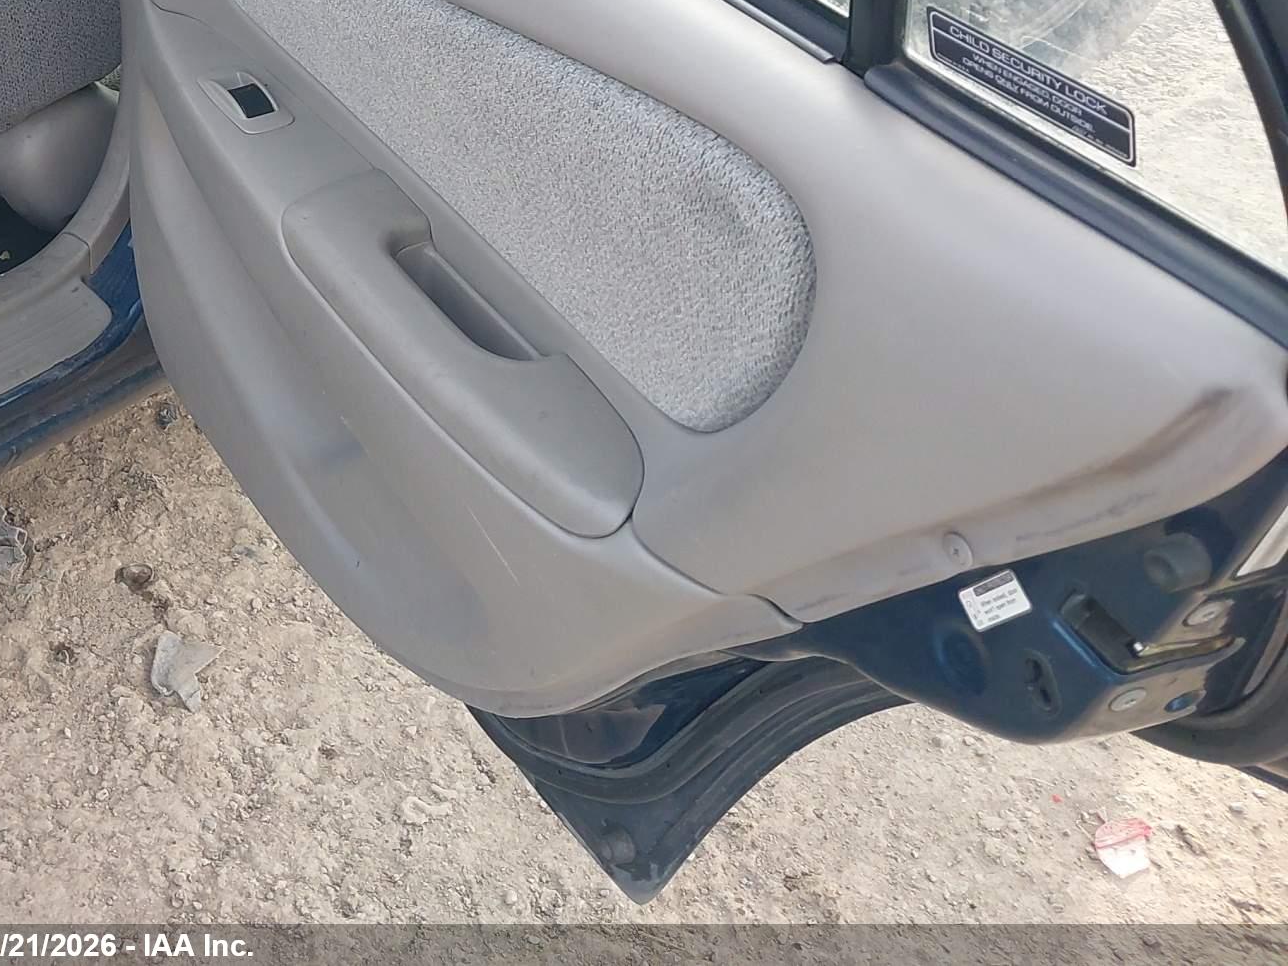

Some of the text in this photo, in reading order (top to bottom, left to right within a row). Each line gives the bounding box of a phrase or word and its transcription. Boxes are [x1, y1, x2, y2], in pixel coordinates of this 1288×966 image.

[950, 26, 990, 53] CHILD
[992, 47, 1062, 90] SECURITY
[1065, 85, 1108, 115] LOCK
[962, 56, 994, 79] OPENS
[994, 74, 1020, 94] ONLY
[1020, 87, 1050, 109] FROM
[972, 53, 1002, 74] WHEN
[1053, 95, 1082, 116] DOOR
